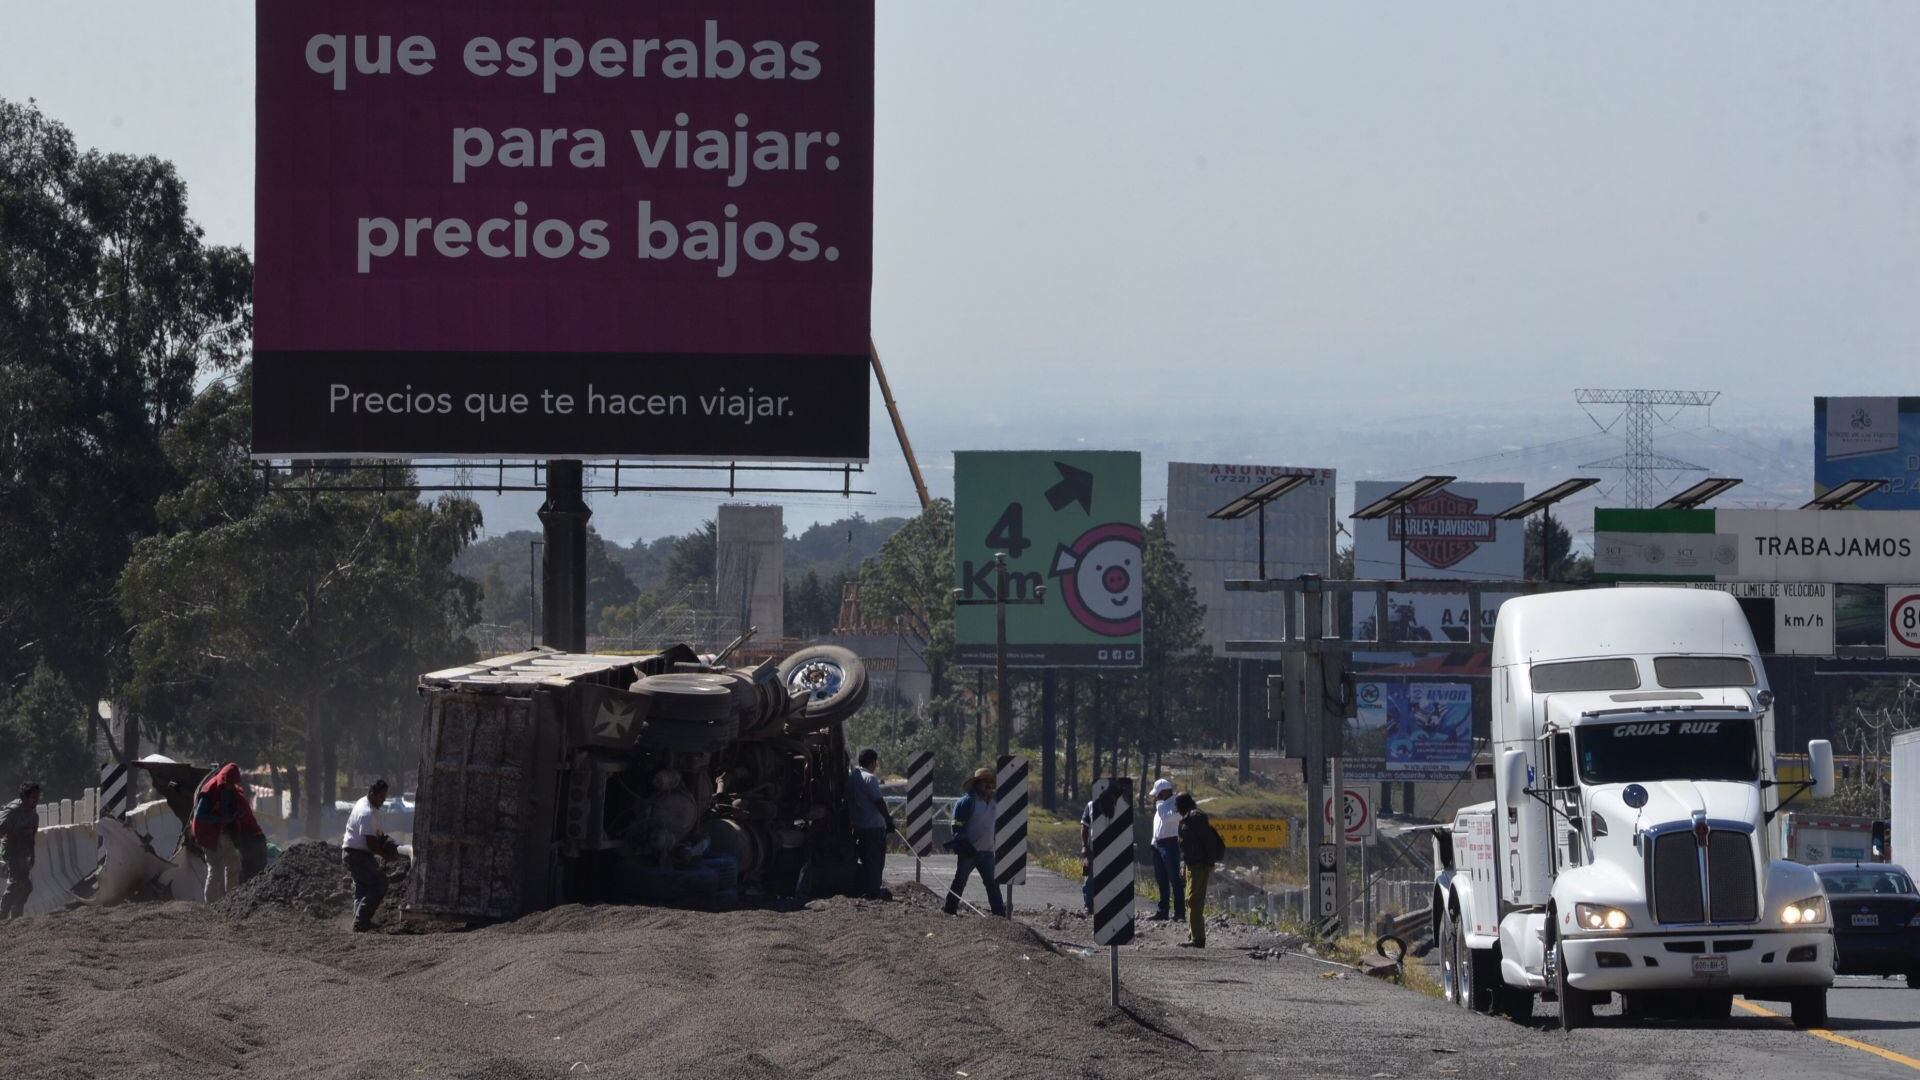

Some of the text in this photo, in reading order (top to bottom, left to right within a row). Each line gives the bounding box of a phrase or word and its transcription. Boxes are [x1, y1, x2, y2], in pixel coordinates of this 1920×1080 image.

[306, 20, 820, 93] que esperabas
[453, 113, 839, 186] para viajar:
[358, 201, 838, 277] precios bajos.
[331, 384, 793, 424] Precios que te hacen viajar.
[1418, 501, 1468, 514] MOTOR
[985, 502, 1031, 558] 4
[1395, 518, 1489, 537] HARLEY-DAVIDSON
[1755, 536, 1911, 557] TRABAJAMOS
[963, 560, 1043, 599] Km
[1731, 583, 1741, 597] EL
[1743, 583, 1765, 597] LIMITE
[1769, 584, 1779, 597] DE
[1783, 584, 1826, 598] VELOCIDAD
[1441, 609, 1453, 625] A
[1784, 614, 1824, 627] km/h
[1903, 606, 1920, 629] 8
[1613, 722, 1721, 737] GRUAS RUIZ
[1322, 852, 1334, 863] 15
[1324, 887, 1332, 896] 4
[1324, 902, 1332, 912] 0
